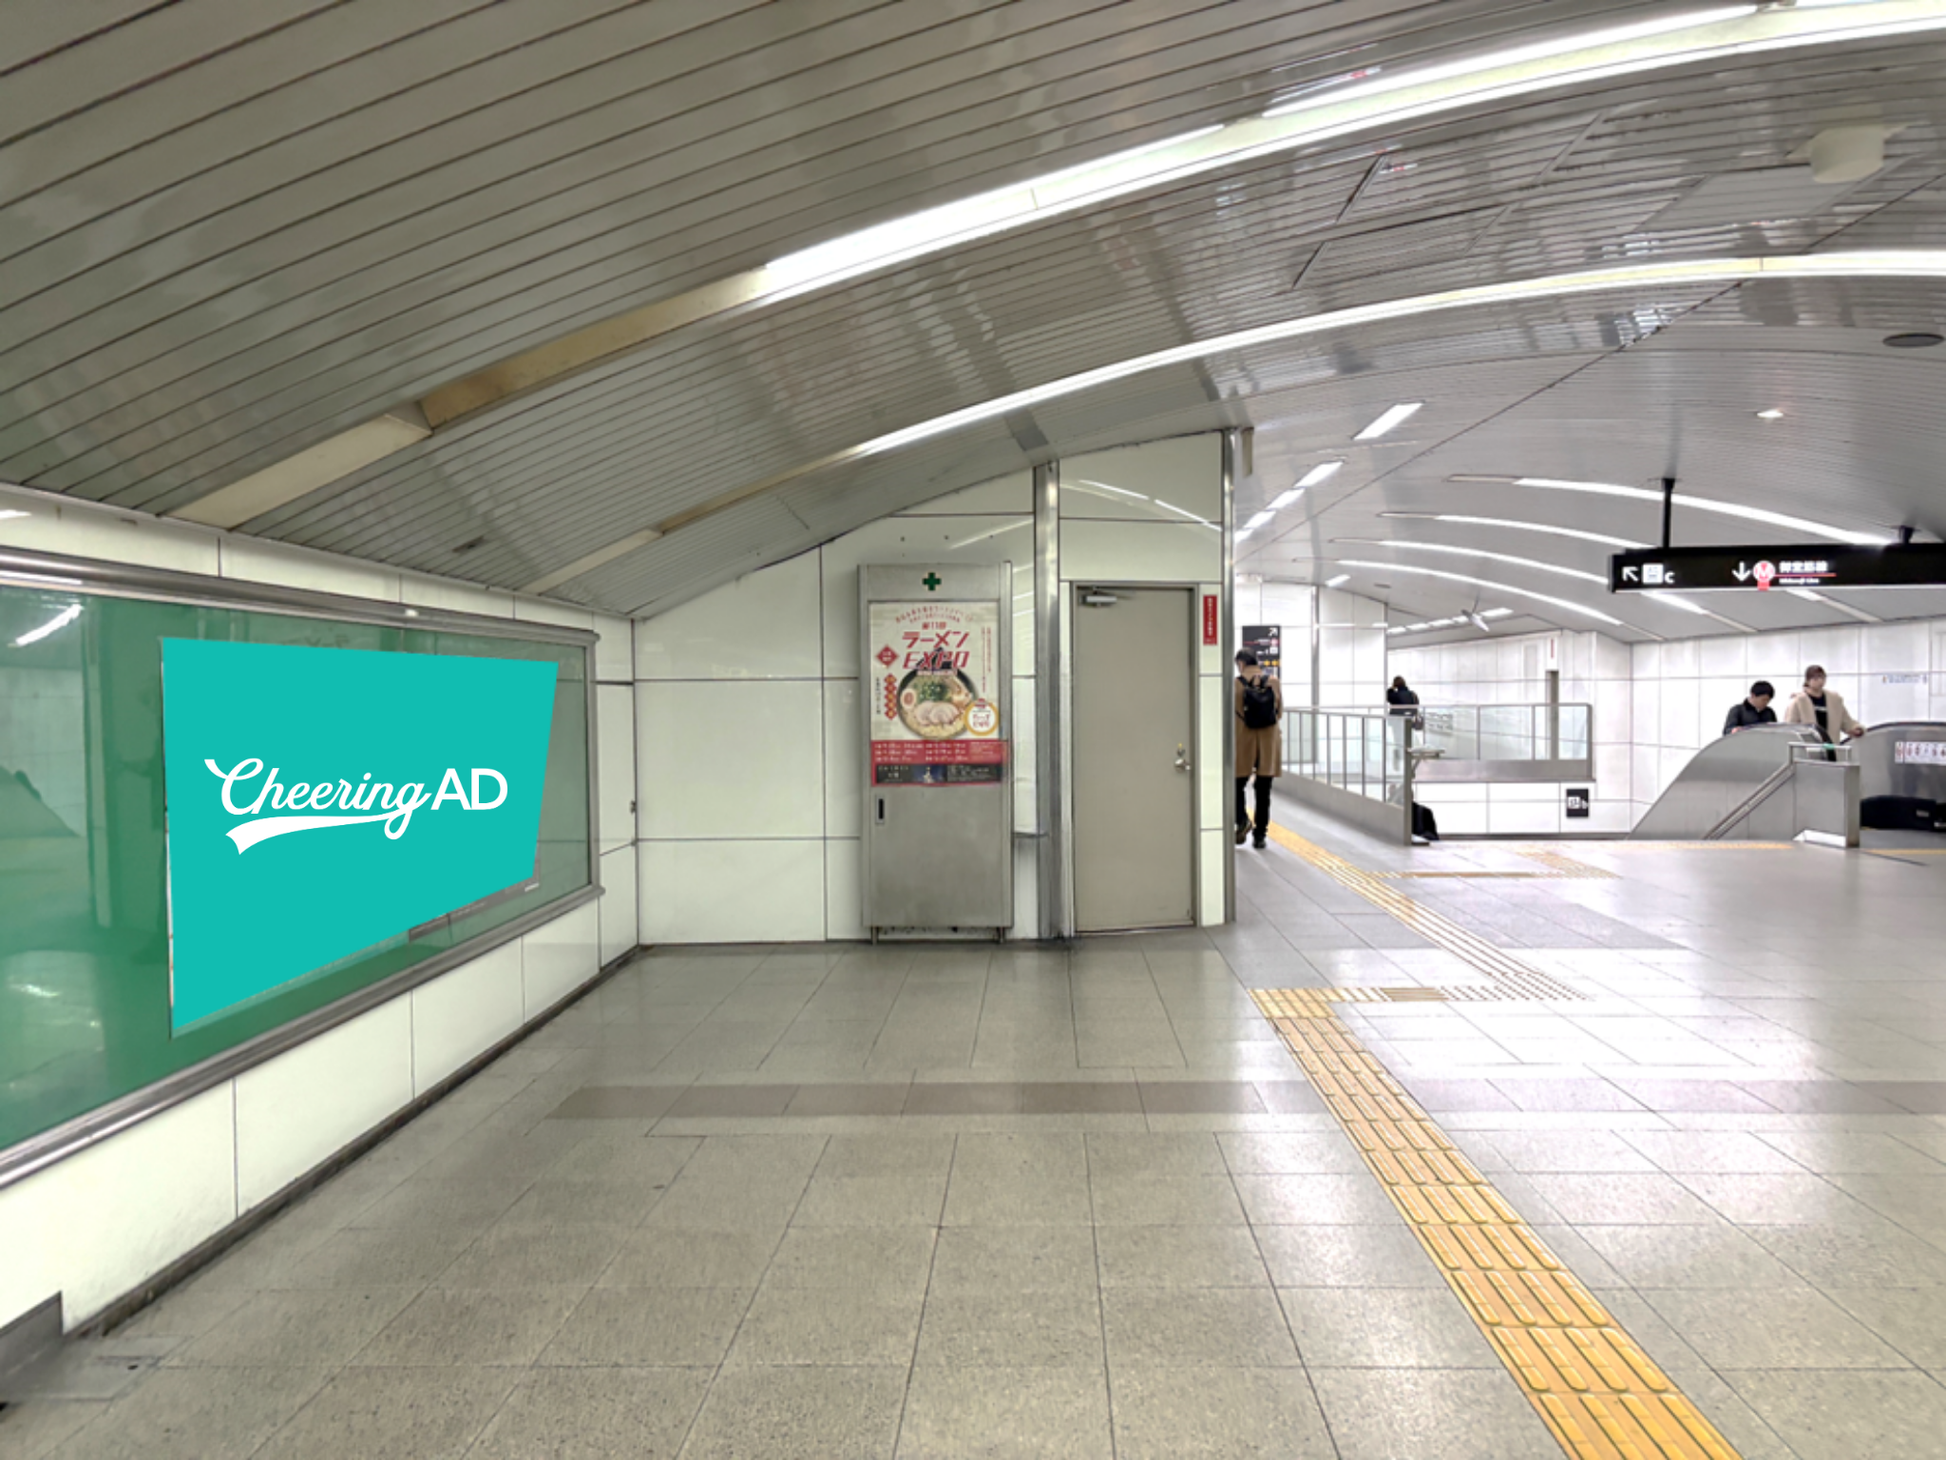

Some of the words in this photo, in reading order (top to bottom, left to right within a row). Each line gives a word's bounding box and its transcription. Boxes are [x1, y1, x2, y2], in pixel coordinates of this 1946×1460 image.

[902, 630, 970, 649] ラーメン
[902, 651, 970, 669] EXPO
[204, 757, 431, 854] Cheering
[431, 767, 508, 811] AD
